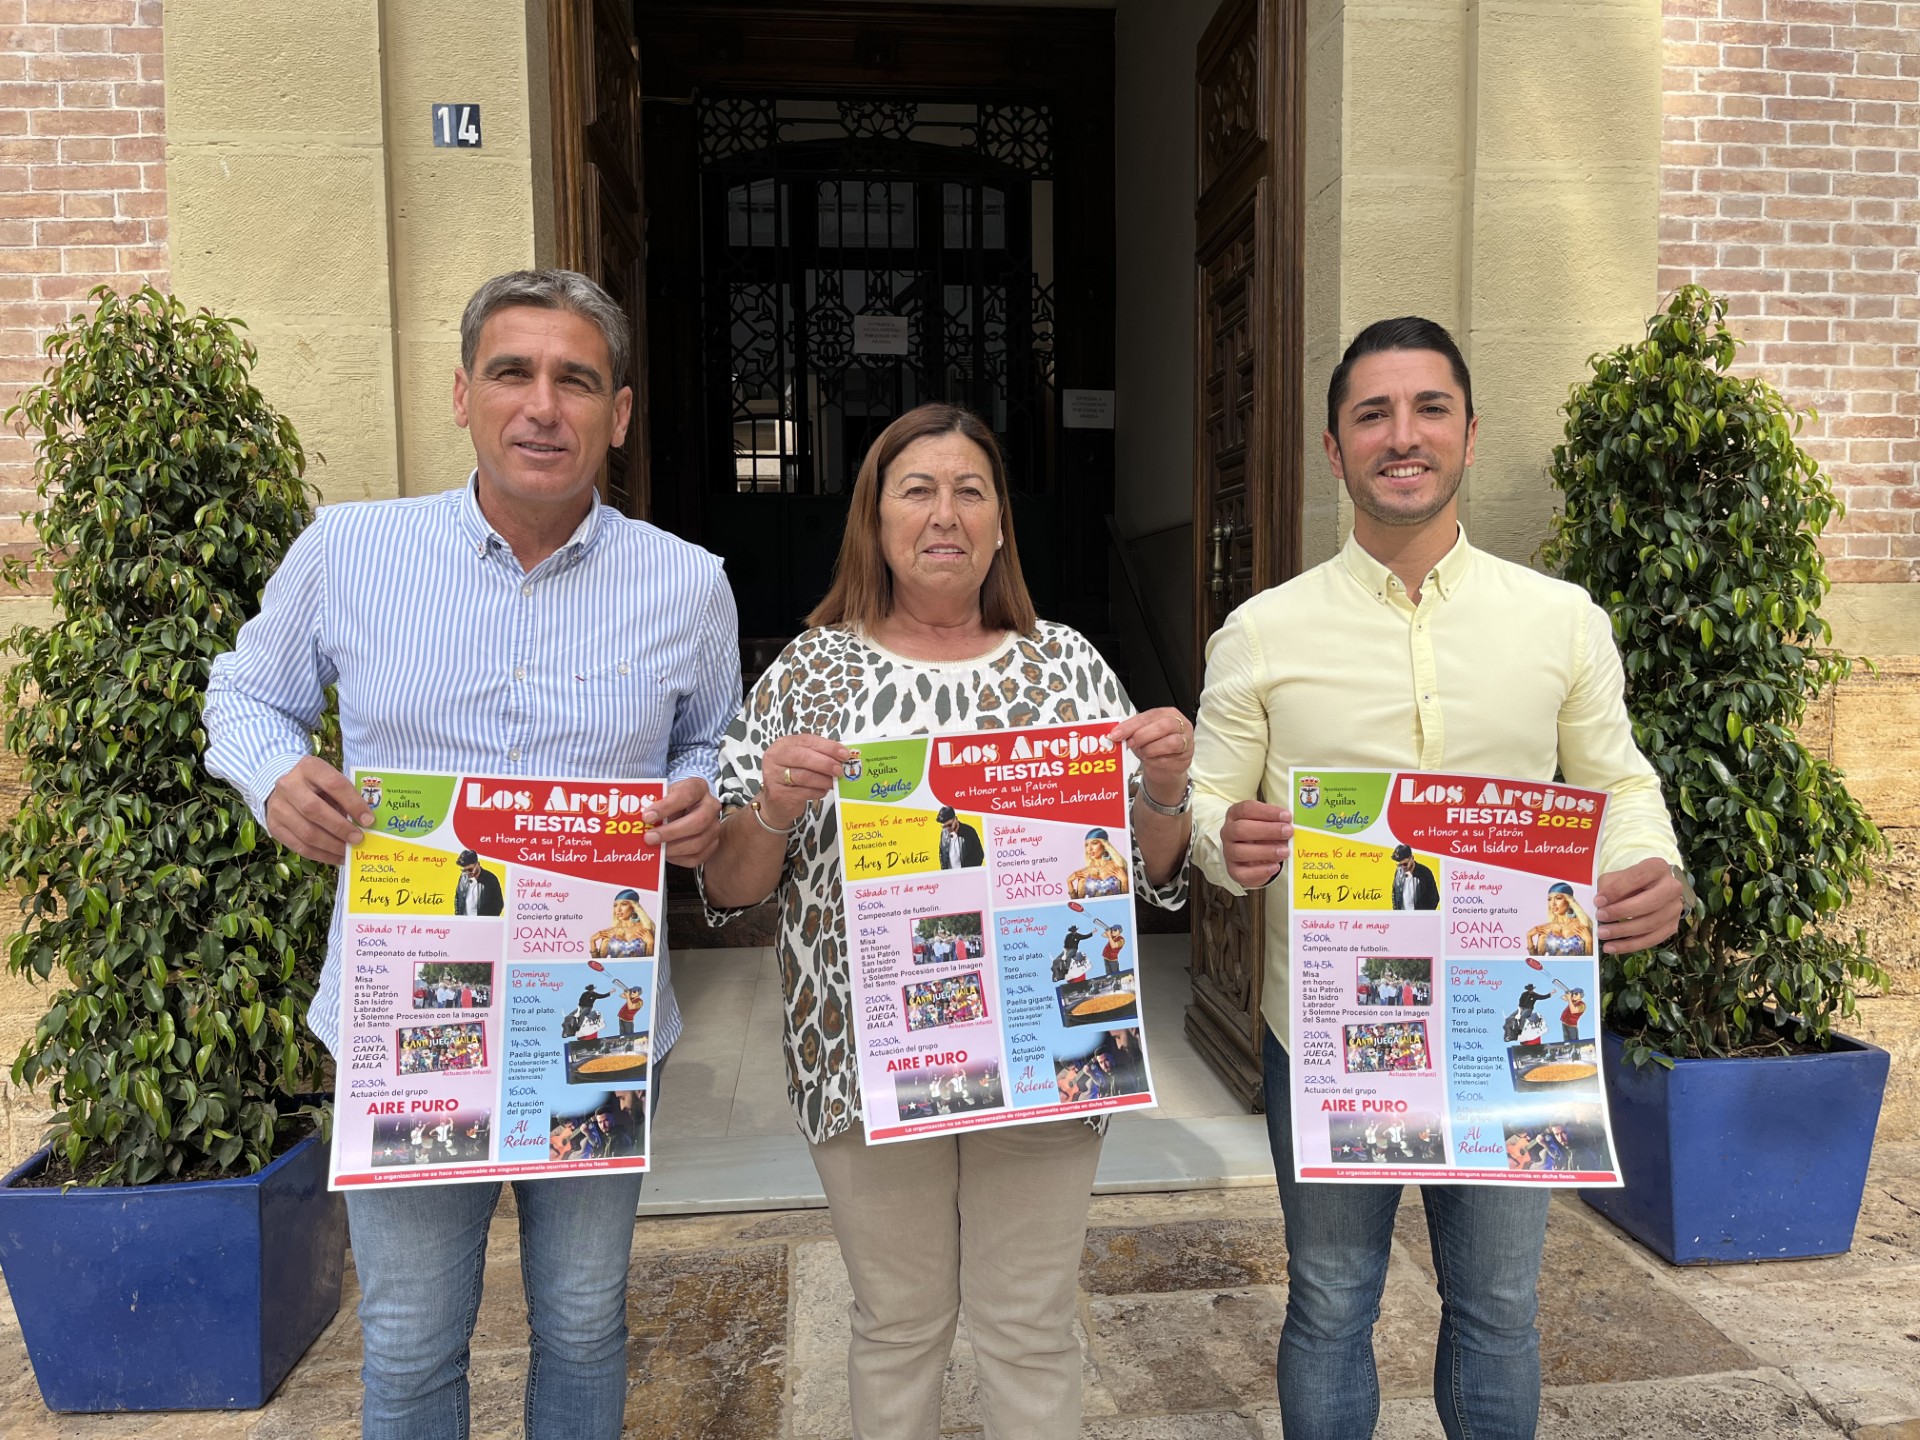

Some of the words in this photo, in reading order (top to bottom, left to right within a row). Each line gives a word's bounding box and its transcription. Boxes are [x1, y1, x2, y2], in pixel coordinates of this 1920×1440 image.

[437, 106, 480, 145] 14
[938, 742, 999, 766] Los
[1010, 731, 1115, 761] Arejos
[985, 760, 1064, 782] FIESTAS
[1068, 759, 1116, 776] 2025
[969, 784, 997, 796] Honor
[1024, 777, 1058, 793] Patrón
[466, 783, 532, 811] Los
[544, 786, 655, 818] Arejos
[991, 797, 1016, 810] San
[1021, 792, 1055, 807] Isidro
[1060, 790, 1118, 804] Labrador
[1324, 796, 1355, 808] Águilas
[1400, 779, 1464, 804] Los
[1476, 782, 1597, 813] Arejos
[386, 798, 420, 811] Águilas
[515, 814, 600, 833] FIESTAS
[846, 819, 876, 830] Viernes
[879, 816, 889, 826] 16
[892, 816, 902, 825] de
[906, 816, 928, 828] mayo
[1447, 808, 1532, 825] FIESTAS
[1537, 814, 1592, 829] 2025
[993, 824, 1025, 836] Sábado
[1428, 826, 1458, 836] Honor
[1488, 826, 1523, 839] Patrón
[496, 833, 526, 844] Honor
[557, 834, 592, 848] Patrón
[852, 840, 886, 851] Actuación
[995, 837, 1003, 847] 17
[1007, 836, 1017, 844] de
[1021, 835, 1042, 847] mayo
[1450, 840, 1477, 853] San
[1483, 840, 1518, 853] Isidro
[1525, 840, 1588, 854] Labrador
[356, 851, 390, 861] Viernes
[394, 852, 404, 861] 16
[408, 853, 419, 862] de
[423, 856, 447, 868] mayo
[517, 847, 546, 862] San
[552, 849, 587, 862] Isidro
[594, 848, 654, 863] Labrador
[997, 858, 1029, 867] Concierto
[1031, 856, 1058, 865] gratuito
[1298, 849, 1328, 858] Viernes
[1333, 848, 1342, 857] 16
[1360, 852, 1383, 862] mayo
[996, 870, 1046, 887] JOANA
[1451, 871, 1485, 880] Sábado
[517, 878, 553, 888] Sábado
[1452, 882, 1460, 891] 17
[1480, 884, 1502, 895] mayo
[517, 889, 526, 898] 17
[546, 891, 569, 902] mayo
[855, 886, 887, 899] Sábado
[891, 886, 900, 895] 17
[903, 884, 914, 893] de
[917, 883, 939, 896] mayo
[1006, 883, 1063, 900] SANTOS
[999, 913, 1034, 930] Domingo
[1302, 920, 1335, 929] Sábado
[1340, 921, 1348, 930] 17
[1366, 924, 1389, 934] mayo
[1450, 922, 1503, 934] JOANA
[356, 924, 392, 933] Sábado
[397, 926, 406, 934] 17
[425, 928, 450, 939] mayo
[513, 927, 568, 940] JOANA
[1000, 926, 1009, 935] 18
[1013, 926, 1022, 934] de
[1026, 924, 1048, 937] mayo
[523, 941, 584, 953] SANTOS
[1461, 937, 1521, 948] SANTOS
[512, 968, 550, 982] Domingo
[1450, 966, 1488, 979] Domingo
[512, 980, 522, 988] 18
[540, 981, 564, 991] mayo
[1451, 977, 1460, 985] 18
[1479, 980, 1502, 990] mayo
[866, 1004, 898, 1014] CANTA,
[866, 1011, 898, 1022] JUEGA,
[867, 1020, 893, 1030] BAILA
[353, 1045, 389, 1053] CANTA,
[870, 1046, 904, 1058] Actuación
[918, 1043, 938, 1052] grupo
[352, 1053, 389, 1062] JUEGA,
[886, 1056, 920, 1072] AIRE
[925, 1050, 968, 1067] PURO
[1020, 1066, 1035, 1080] Al
[1014, 1080, 1055, 1093] Relente
[350, 1089, 390, 1098] Actuación
[367, 1101, 405, 1115] AIRE
[411, 1098, 459, 1113] PURO
[1322, 1099, 1356, 1111] AIRE
[1362, 1100, 1408, 1112] PURO
[511, 1121, 530, 1134] Al
[1464, 1126, 1481, 1140] Al
[503, 1134, 548, 1148] Relente
[1458, 1142, 1504, 1153] Relente
